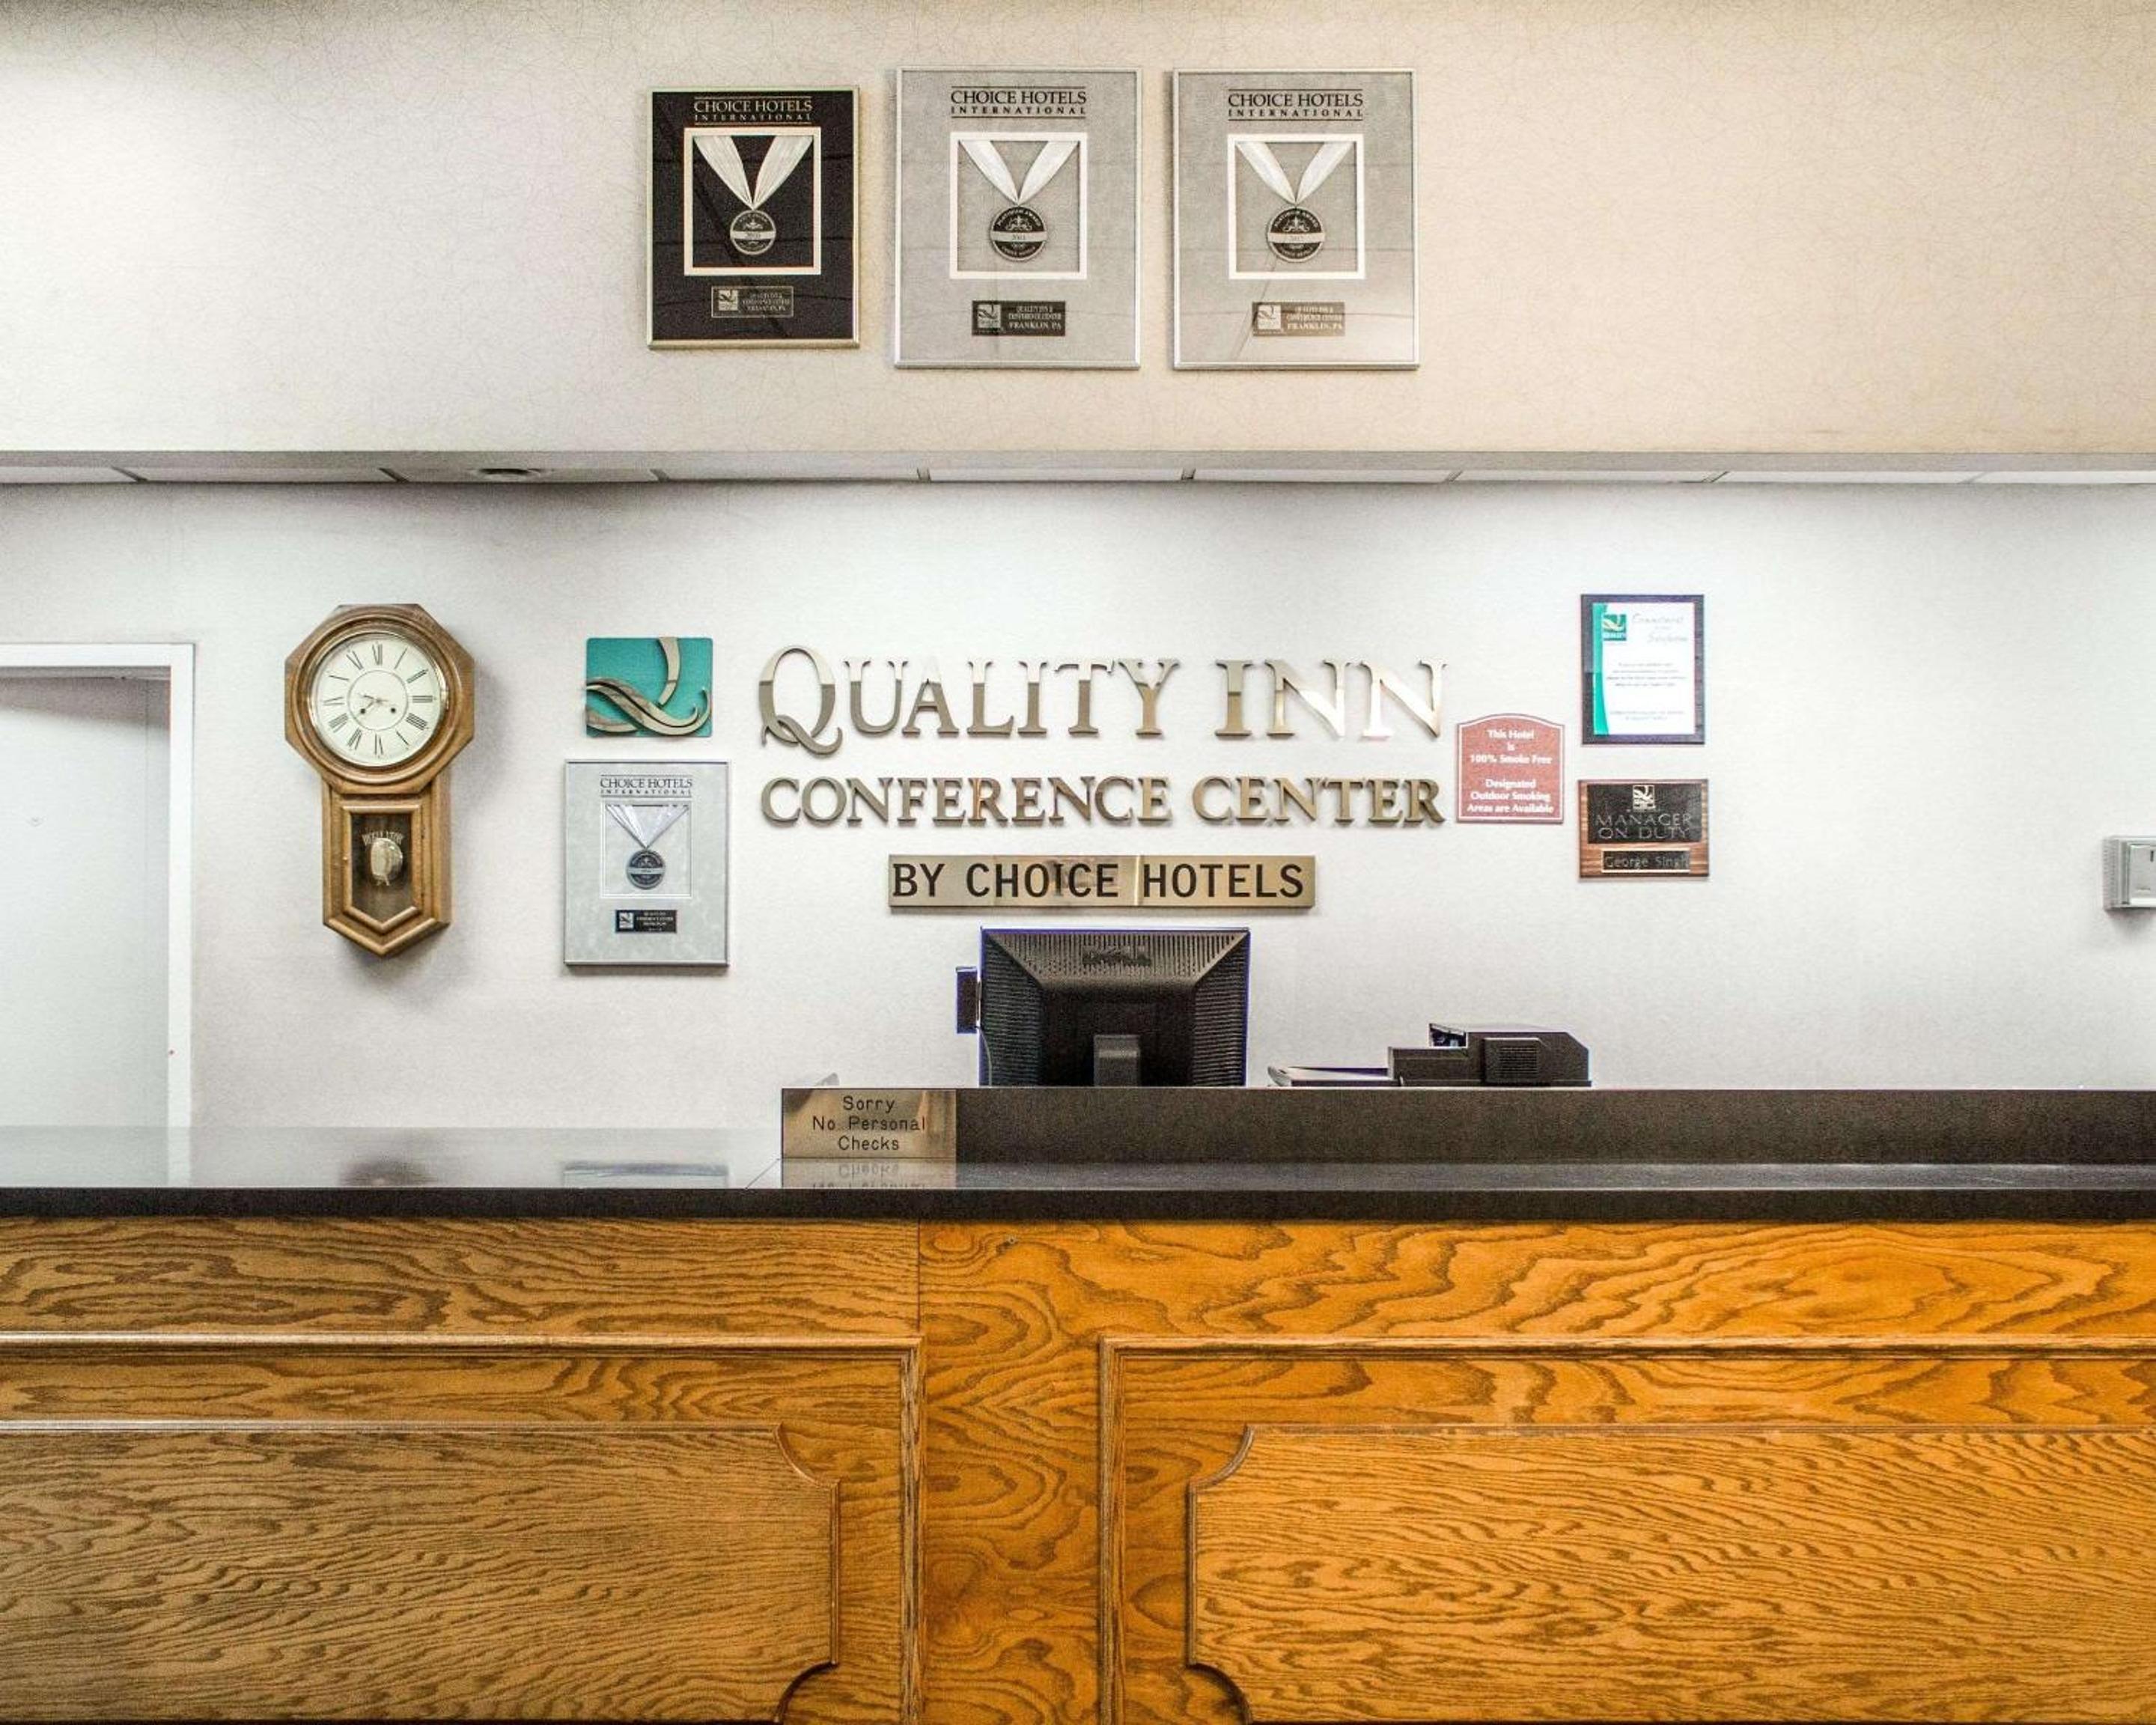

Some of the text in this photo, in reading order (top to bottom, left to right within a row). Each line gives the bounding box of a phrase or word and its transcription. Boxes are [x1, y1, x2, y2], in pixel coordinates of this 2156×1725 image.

[950, 90, 1087, 104] CHOICE HOTELS
[1228, 93, 1363, 107] CHOICE HOTELS
[693, 100, 813, 112] CHOICE HOTELS
[951, 106, 1086, 115] INTERNATIONAL
[694, 114, 811, 122] INTERNATIONAL
[1228, 109, 1363, 117] INTERNATIONAL
[758, 647, 1447, 755] QUALITY INN
[1487, 729, 1535, 739] This Hotel
[1470, 754, 1553, 764] 100% Smoke Free
[600, 777, 693, 788] CHOICE HOTELS
[1485, 779, 1536, 790] Designated
[761, 776, 1446, 825] CONFERENCE CENTER
[1470, 791, 1551, 803] Outdoor Smoking
[1467, 803, 1493, 813] Areas
[1511, 803, 1554, 813] Available
[1596, 812, 1692, 826] MANAGER
[1598, 826, 1690, 839] ON DUTY
[1605, 856, 1649, 870] George
[892, 862, 1304, 898] BY CHOICE HOTELS
[842, 1095, 895, 1114] Sorry
[812, 1116, 925, 1131] No Personal
[838, 1135, 900, 1151] Checks
